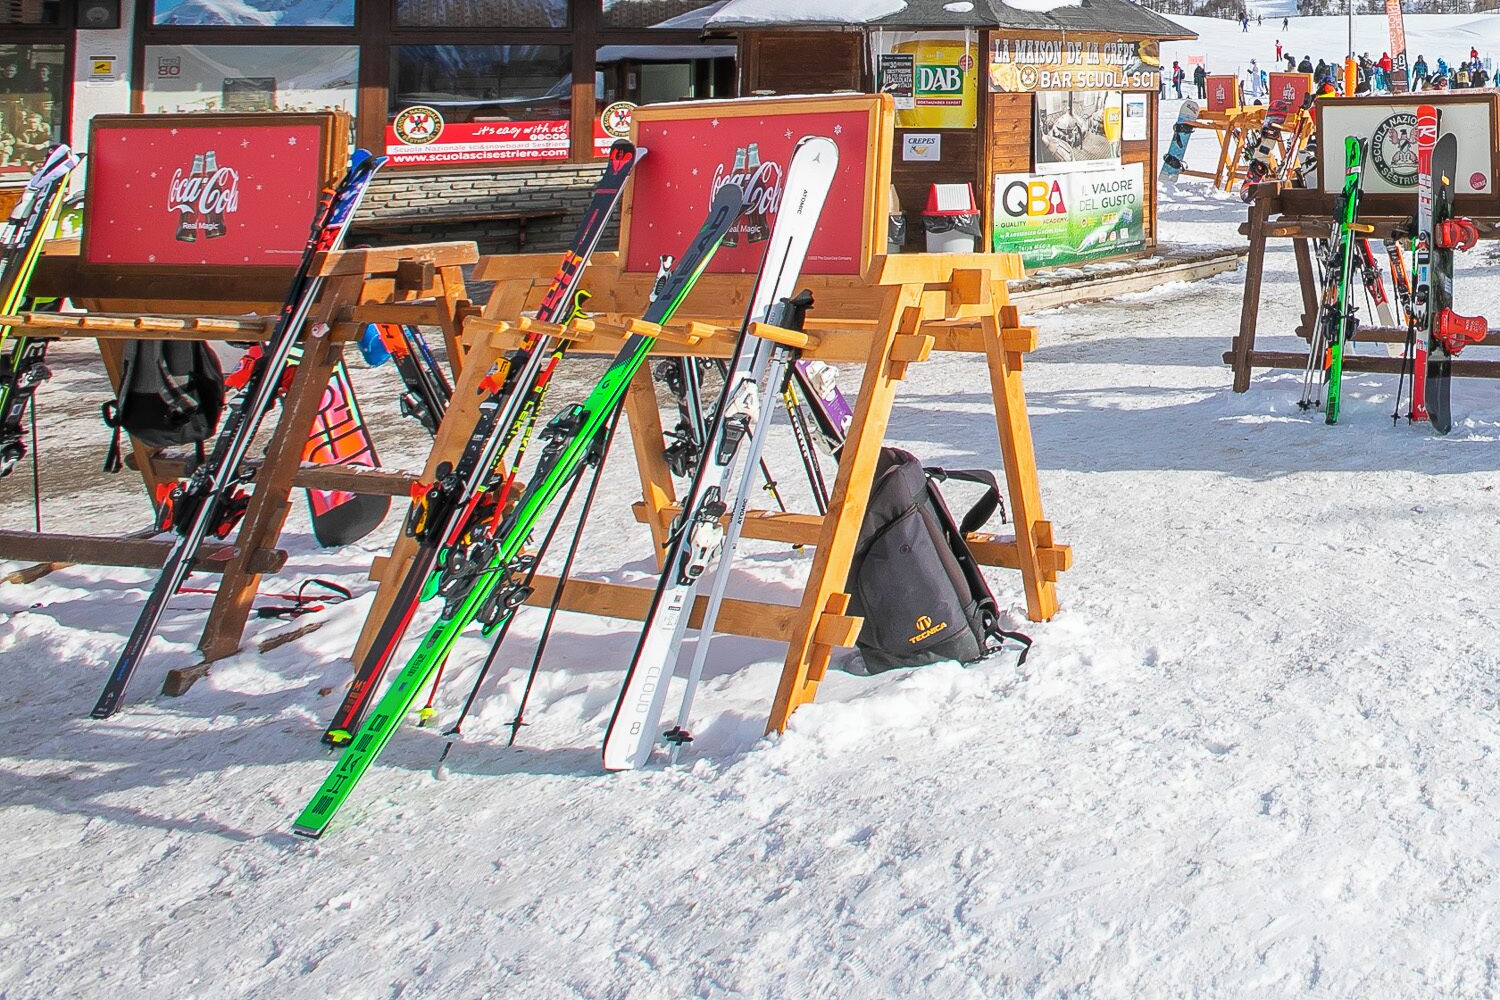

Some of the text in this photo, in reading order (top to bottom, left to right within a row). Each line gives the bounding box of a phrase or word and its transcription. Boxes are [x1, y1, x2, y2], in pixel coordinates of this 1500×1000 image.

[994, 37, 1135, 65] LA MAISON DE LA CRÊPE
[158, 65, 180, 75] 80
[919, 67, 961, 92] DAB
[1132, 71, 1154, 88] SCI
[496, 126, 520, 139] easy
[523, 124, 550, 136] with
[550, 123, 568, 134] us!
[1371, 114, 1418, 164] SCUOLA NAZIO
[394, 146, 422, 154] Scuola
[425, 144, 466, 152] Nazionale
[908, 137, 936, 145] CREPES
[393, 149, 568, 163] www.scuolascisestriere.com
[1381, 167, 1419, 186] SESTRIE
[167, 166, 239, 214] Coca-Cola
[1092, 179, 1133, 194] VALORE
[796, 189, 808, 215] ATOMIC
[1002, 180, 1067, 218] QBA
[1079, 193, 1136, 212] DEL GUSTO
[182, 221, 220, 231] Real Magic
[740, 224, 761, 235] Magic
[1000, 220, 1027, 229] QUALITY
[737, 498, 748, 525] ATOMIC
[908, 621, 948, 643] TECNICA
[636, 666, 660, 713] CLOUD
[630, 721, 641, 735] 8
